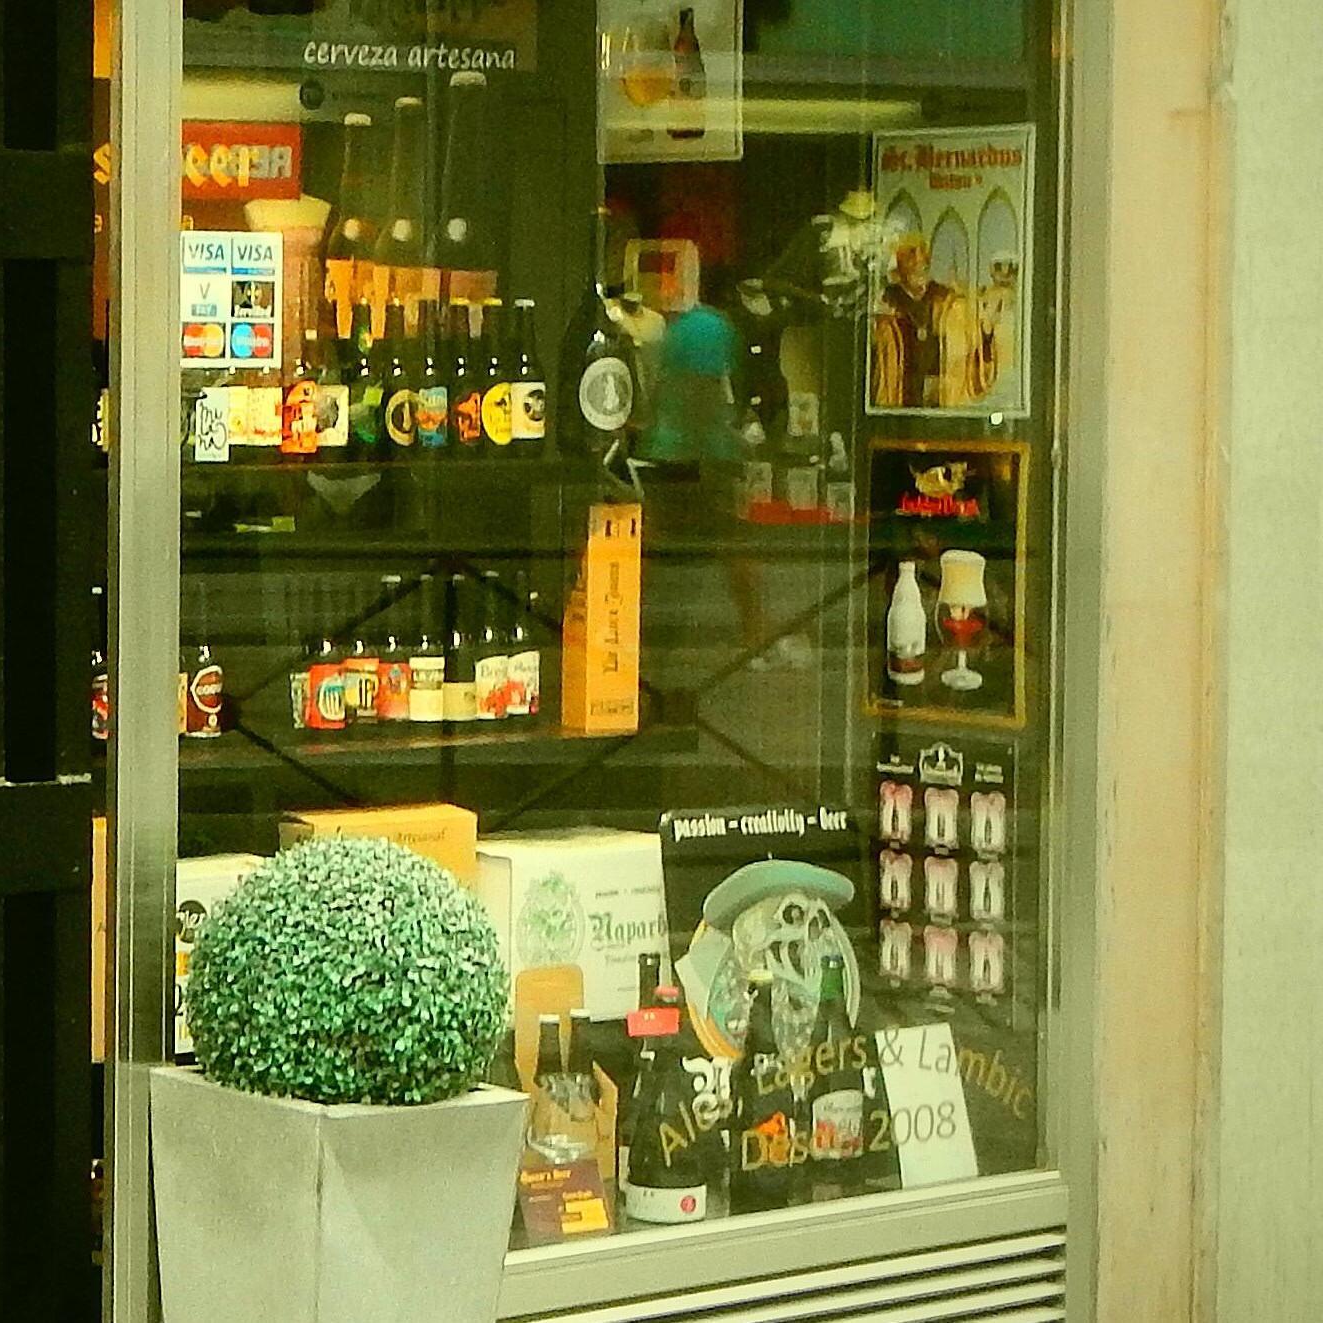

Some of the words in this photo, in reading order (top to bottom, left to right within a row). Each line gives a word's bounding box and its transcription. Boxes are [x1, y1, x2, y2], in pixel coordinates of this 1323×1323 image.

[304, 40, 398, 67] cerveza
[408, 44, 516, 69] artesana
[188, 243, 225, 261] VISA
[237, 244, 274, 261] VISA
[674, 813, 726, 842] passion
[880, 1024, 904, 1065] &
[918, 1027, 1036, 1120] Lambic
[869, 1102, 956, 1153] 2008
